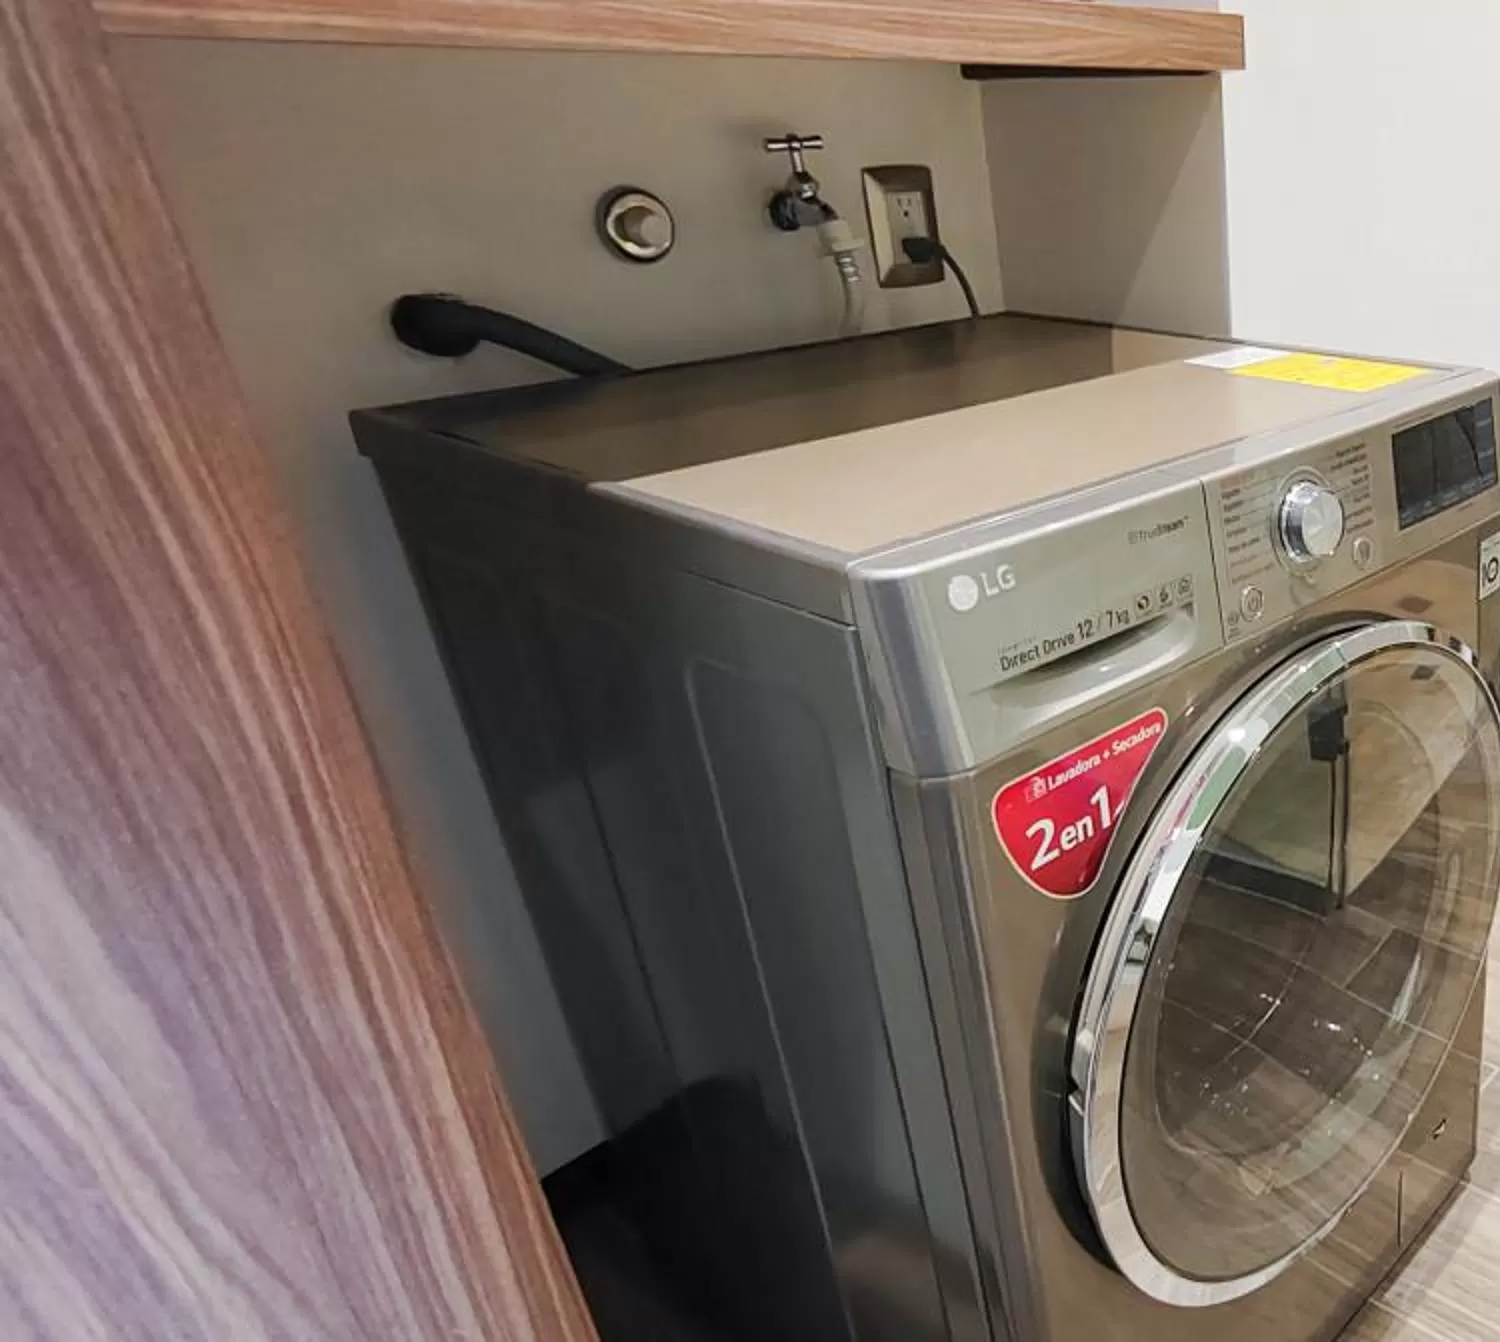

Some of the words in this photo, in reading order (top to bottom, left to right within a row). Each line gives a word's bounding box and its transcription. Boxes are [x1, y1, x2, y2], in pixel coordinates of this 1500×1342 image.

[980, 564, 1016, 597] LG
[1000, 645, 1040, 671] Direct
[1043, 633, 1075, 655] Drive
[1077, 618, 1094, 640] 12
[1048, 756, 1101, 791] Lavadora
[1112, 722, 1162, 755] Secadora
